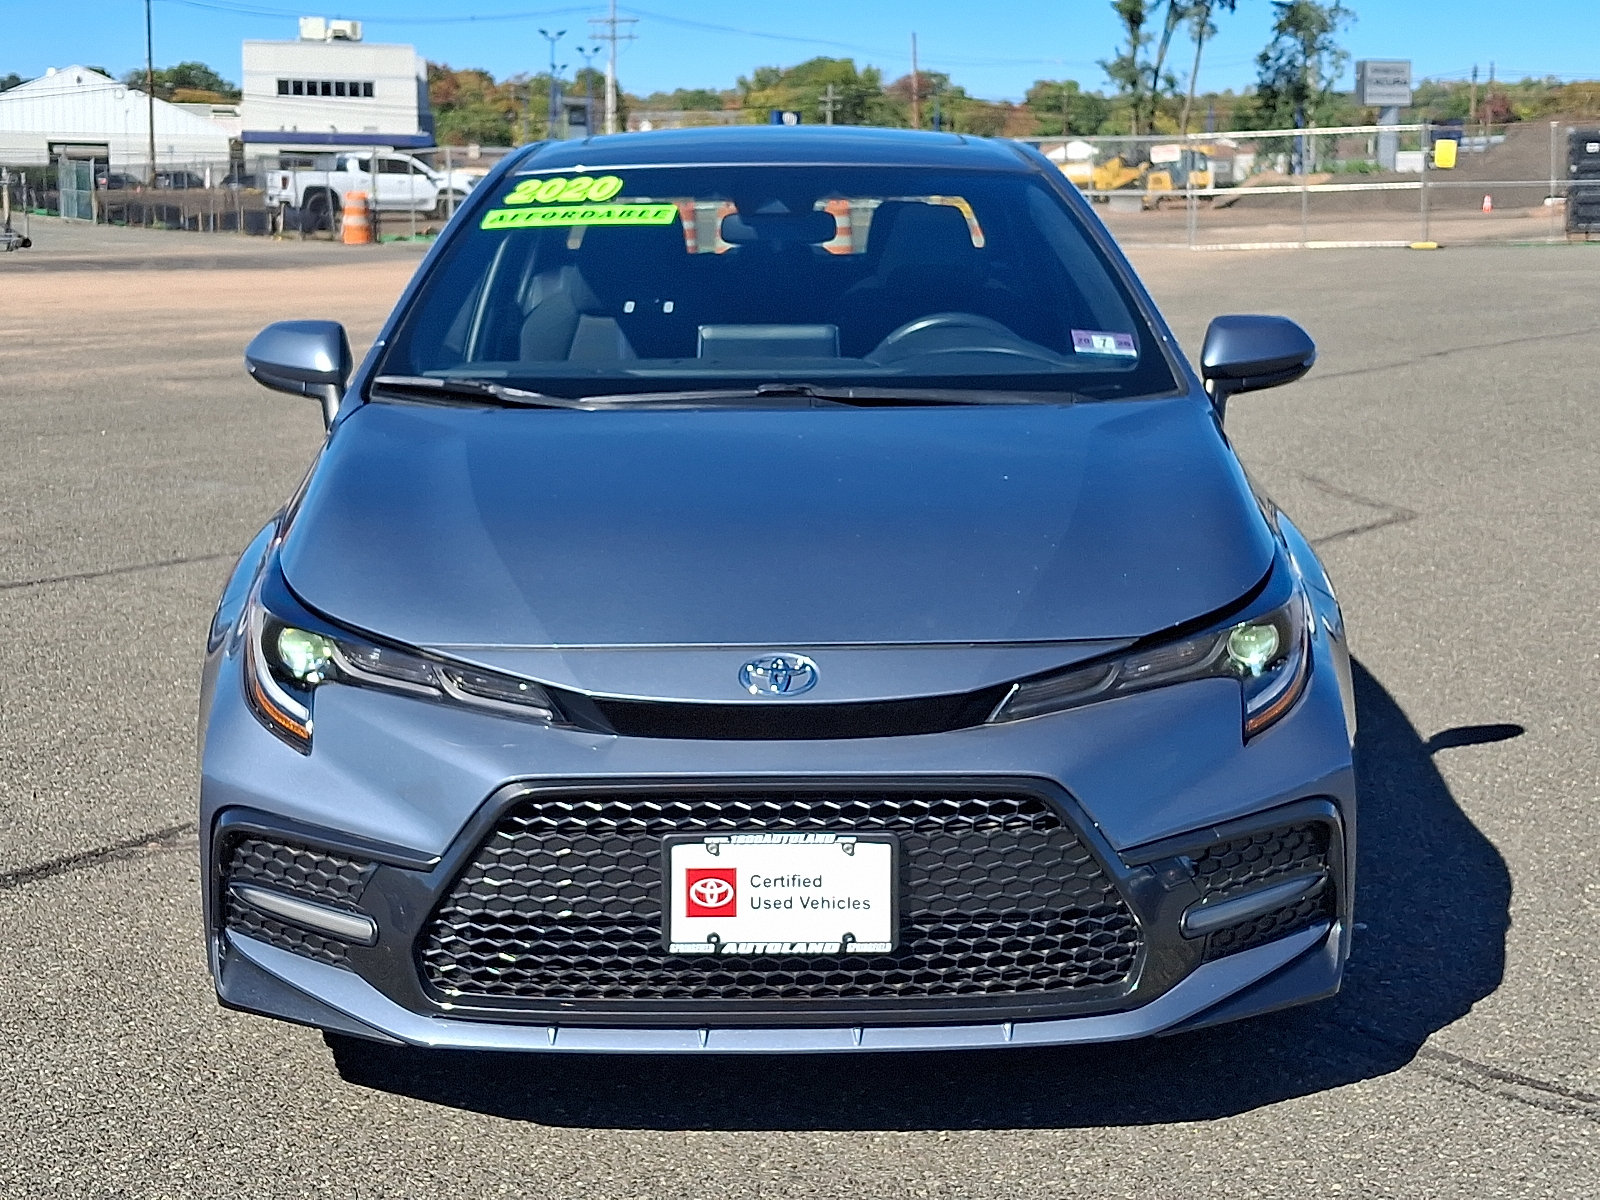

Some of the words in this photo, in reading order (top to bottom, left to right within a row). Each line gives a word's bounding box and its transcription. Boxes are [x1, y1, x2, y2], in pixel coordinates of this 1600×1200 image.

[503, 175, 624, 205] 2020
[489, 208, 671, 223] AFFORDABLE
[1100, 338, 1107, 348] 7
[750, 874, 822, 888] Certified
[750, 896, 793, 910] Used
[799, 896, 871, 910] Vehicles
[720, 942, 841, 954] AUTOLAND
